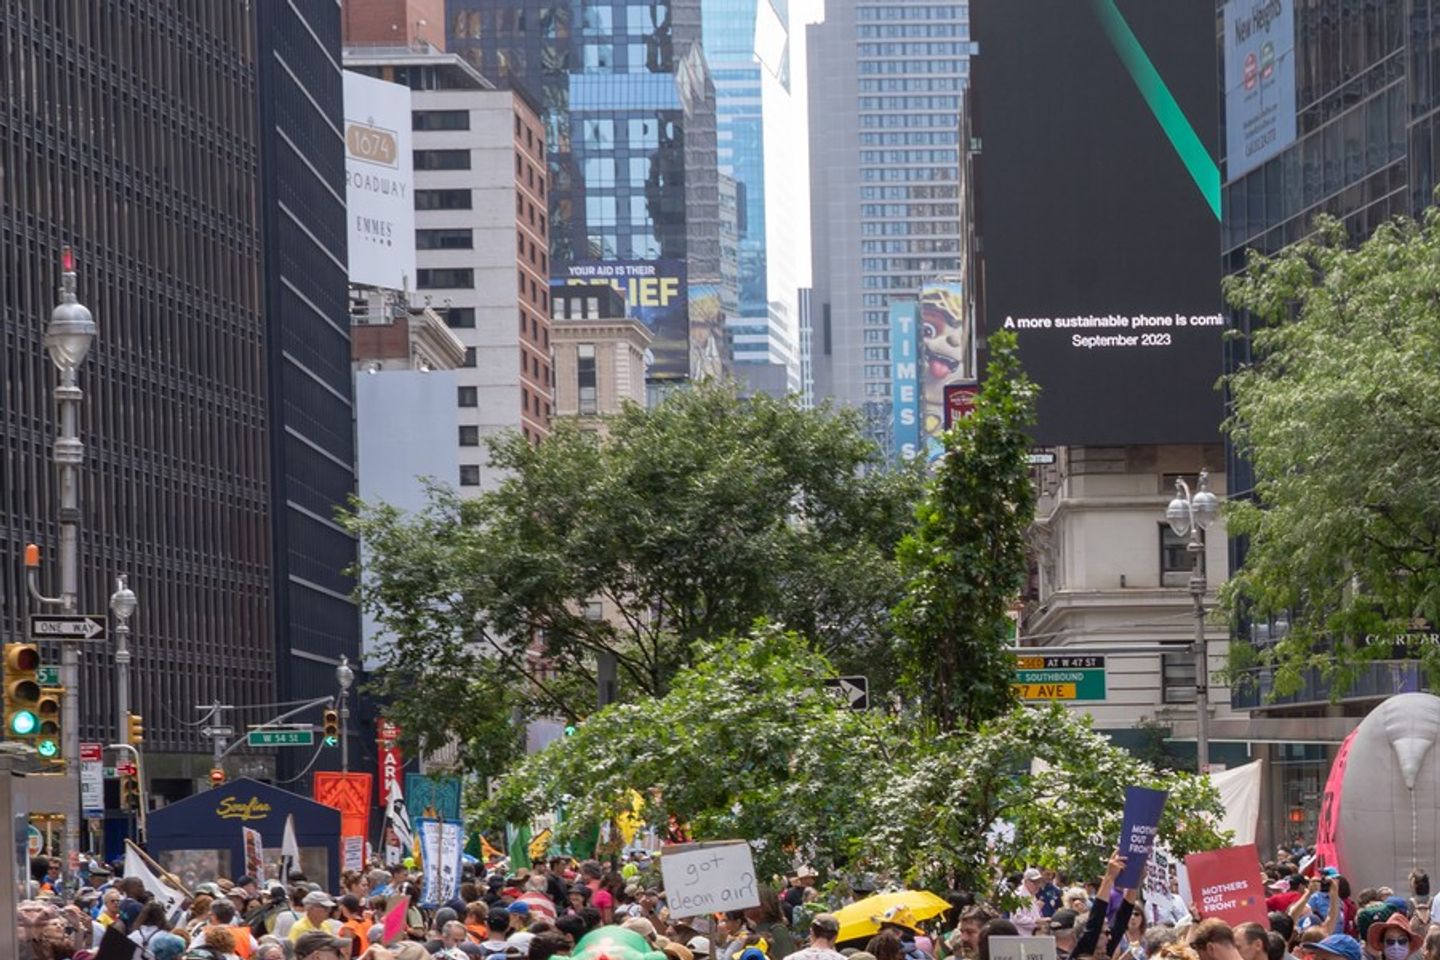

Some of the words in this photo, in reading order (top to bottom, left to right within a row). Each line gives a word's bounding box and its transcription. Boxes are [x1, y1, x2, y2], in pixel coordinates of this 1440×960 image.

[354, 131, 390, 159] 1674
[346, 170, 406, 198] ROADWAY
[568, 266, 596, 275] YOUR
[597, 266, 614, 275] AID
[615, 266, 625, 274] IS
[626, 265, 656, 275] THEIR
[1004, 316, 1015, 328] A
[1017, 318, 1052, 328] more
[1055, 315, 1129, 327] sustainable
[1131, 315, 1173, 329] phone
[1175, 314, 1187, 326] is
[1190, 314, 1230, 326] comi
[1072, 335, 1139, 349] September
[1141, 333, 1172, 346] 2023
[40, 622, 64, 634] ONE
[72, 622, 96, 636] WAY
[1048, 659, 1058, 667] AT
[1062, 659, 1070, 667] W
[1085, 658, 1097, 667] ST
[1026, 673, 1084, 681] SOUTHBOUND
[1038, 685, 1064, 697] AVE
[263, 735, 272, 743] W
[1131, 824, 1158, 836] MOTH
[1130, 835, 1147, 844] OUT
[684, 852, 725, 887] got
[720, 871, 755, 901] air?
[1202, 880, 1248, 894] MOTHERS
[1203, 894, 1223, 904] OUT
[1204, 900, 1237, 912] FRONT
